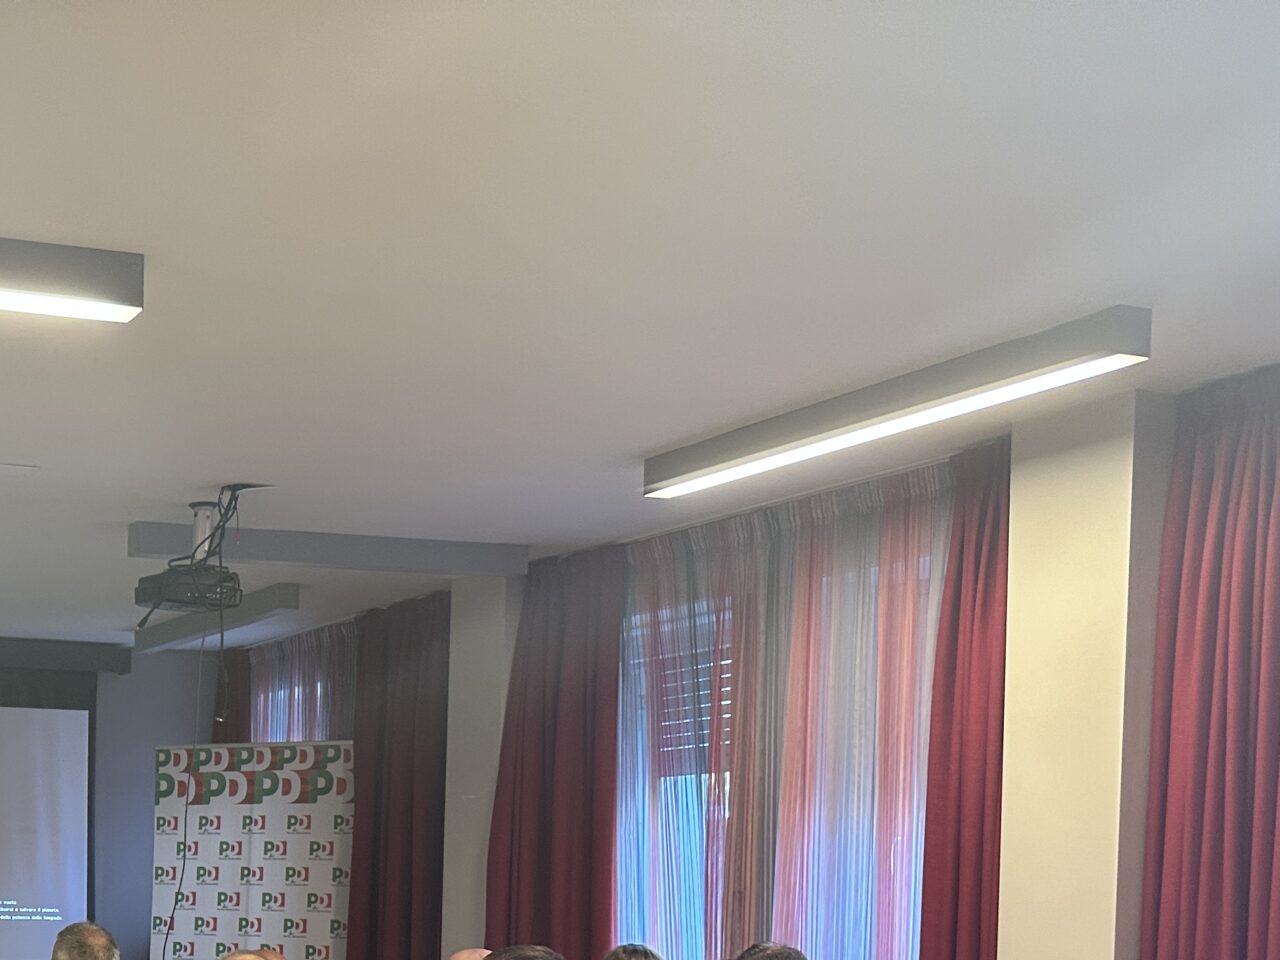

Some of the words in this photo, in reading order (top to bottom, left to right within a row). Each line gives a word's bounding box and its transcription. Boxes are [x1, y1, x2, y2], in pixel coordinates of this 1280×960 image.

[155, 772, 196, 805] PD
[204, 772, 247, 804] PD
[254, 771, 301, 803] PD
[309, 769, 354, 803] PD
[156, 816, 178, 830] PD
[198, 816, 220, 829] PD
[242, 815, 266, 829] PD
[287, 815, 312, 829] PD
[176, 841, 199, 855] PD
[219, 841, 242, 855] PD
[264, 841, 287, 855] PD
[309, 841, 334, 856] PD
[154, 867, 177, 880] PD
[196, 867, 219, 881] PD
[240, 867, 264, 881] PD
[285, 867, 309, 881] PD
[175, 891, 196, 906] PD
[217, 892, 240, 906] PD
[261, 892, 285, 907] PD
[307, 893, 332, 908] PD
[152, 916, 175, 930] PD
[194, 917, 217, 931] PD
[238, 917, 262, 932] PD
[283, 918, 307, 933] PD
[173, 941, 195, 956] PD
[305, 945, 330, 960] PD
